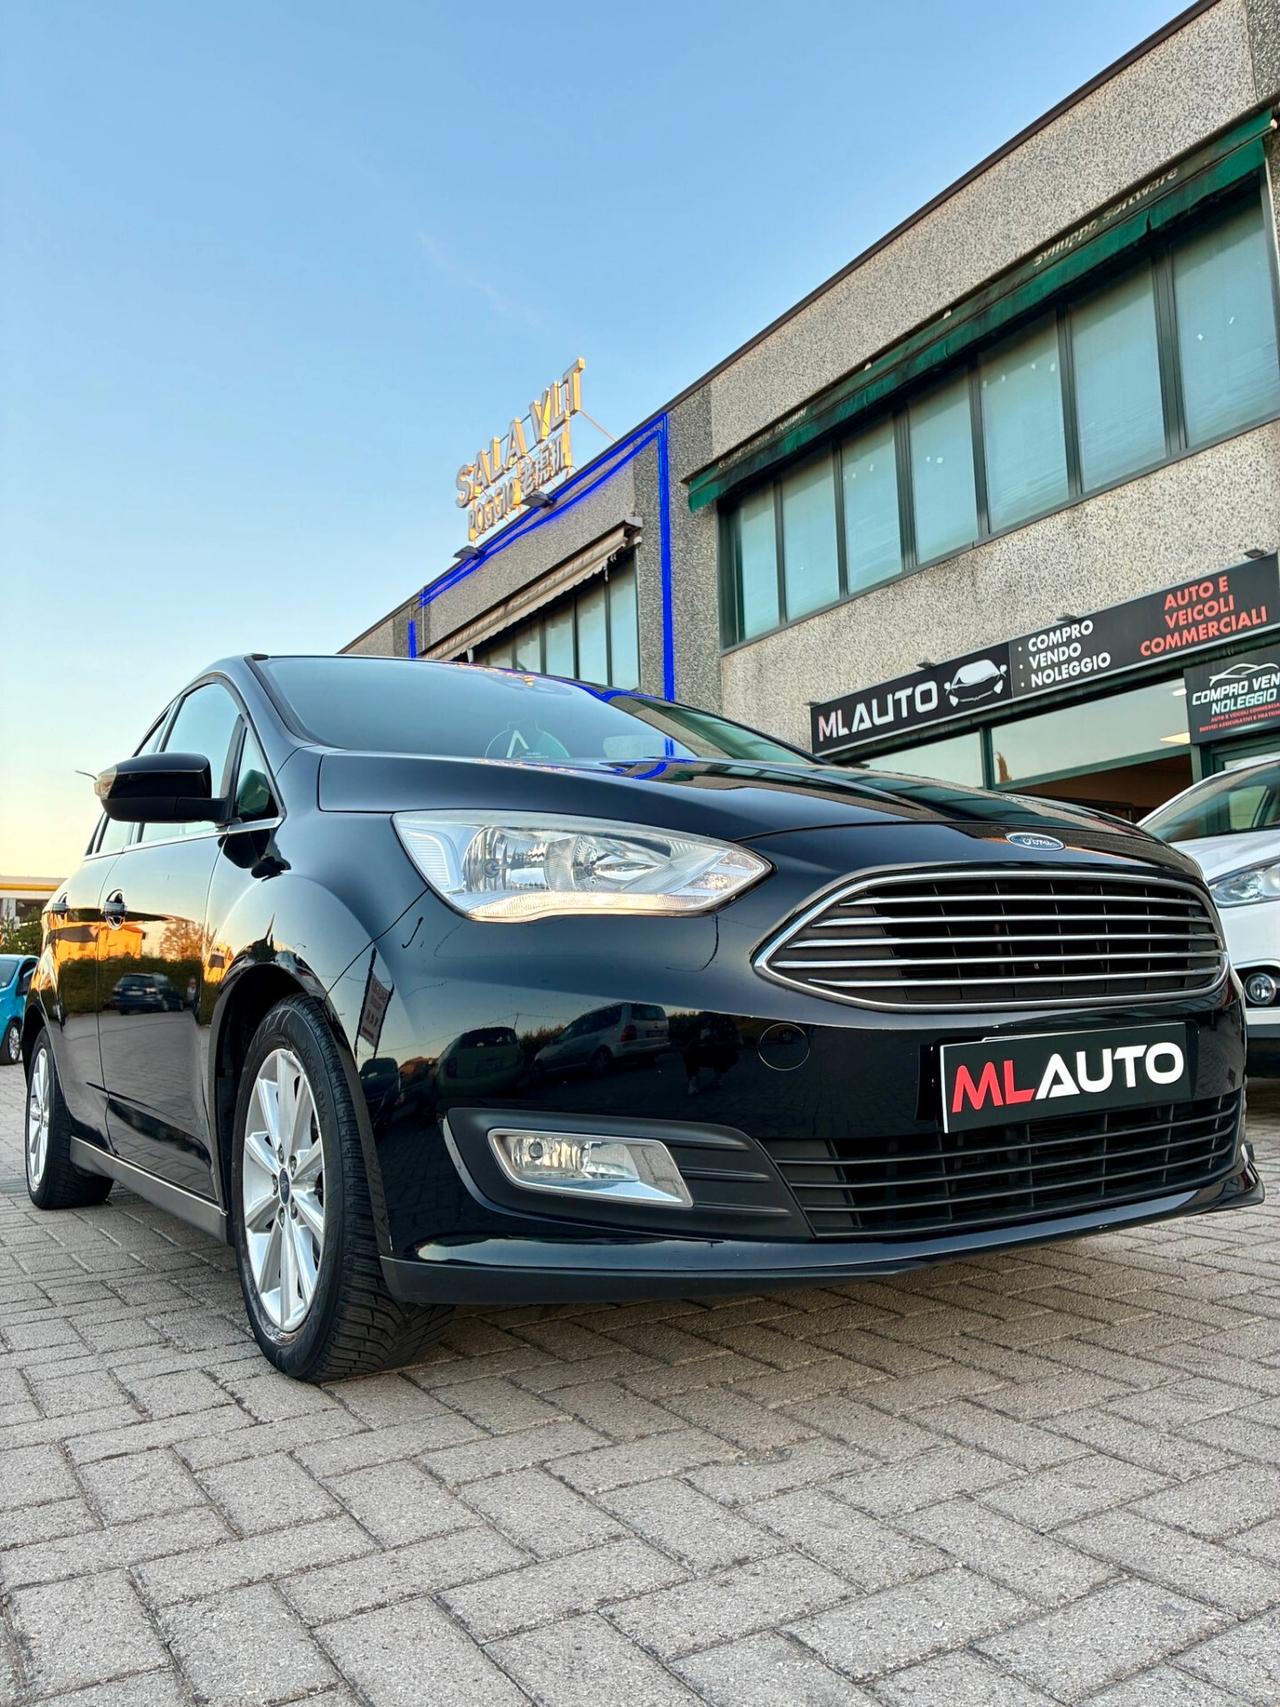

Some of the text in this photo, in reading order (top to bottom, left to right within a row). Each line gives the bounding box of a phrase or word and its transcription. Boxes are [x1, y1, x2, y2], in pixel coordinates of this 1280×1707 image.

[456, 417, 527, 508] SALA
[1164, 575, 1229, 611] AUTO E
[1164, 595, 1235, 629] VEICOLI
[1028, 620, 1094, 652] COMPRO
[1140, 606, 1268, 657] COMMERCIALI
[1029, 642, 1082, 669] VENDO
[1031, 652, 1111, 688] NOLEGGIO
[1192, 680, 1249, 705] COMPRO
[1212, 688, 1278, 715] NOLEGGIO
